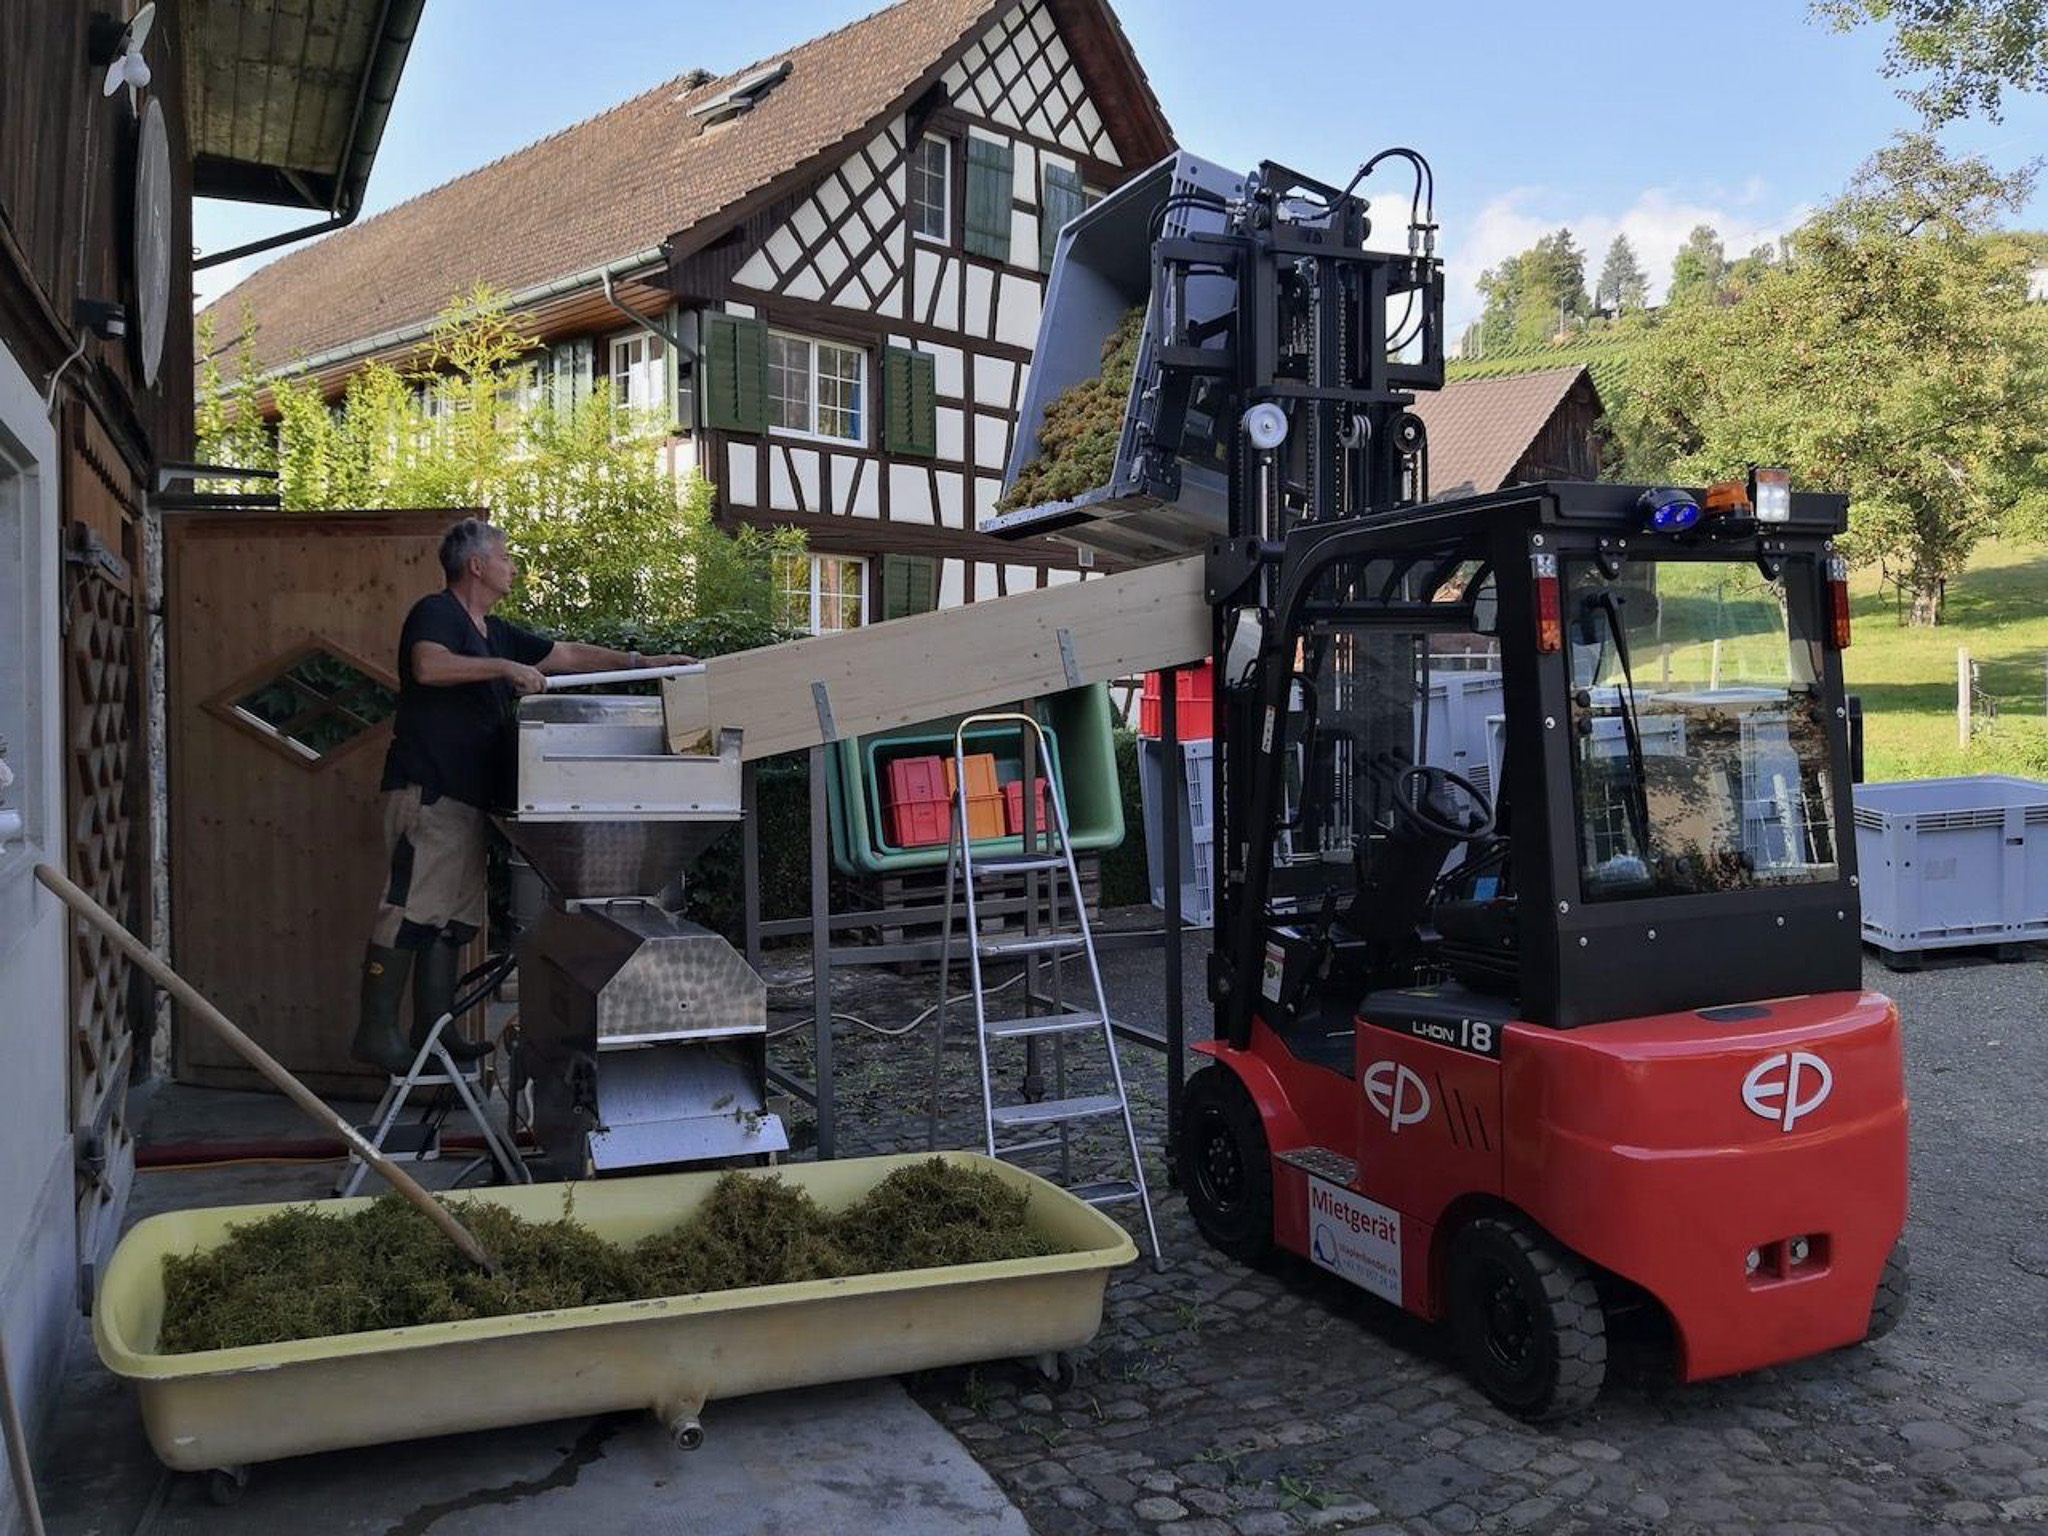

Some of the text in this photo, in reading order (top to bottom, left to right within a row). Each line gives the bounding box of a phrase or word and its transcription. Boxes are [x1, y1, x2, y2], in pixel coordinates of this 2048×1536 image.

[1461, 1018, 1492, 1052] 18
[1363, 1060, 1432, 1133] EP
[1742, 1052, 1833, 1132] EP
[1312, 1187, 1397, 1244] Mietgerät
